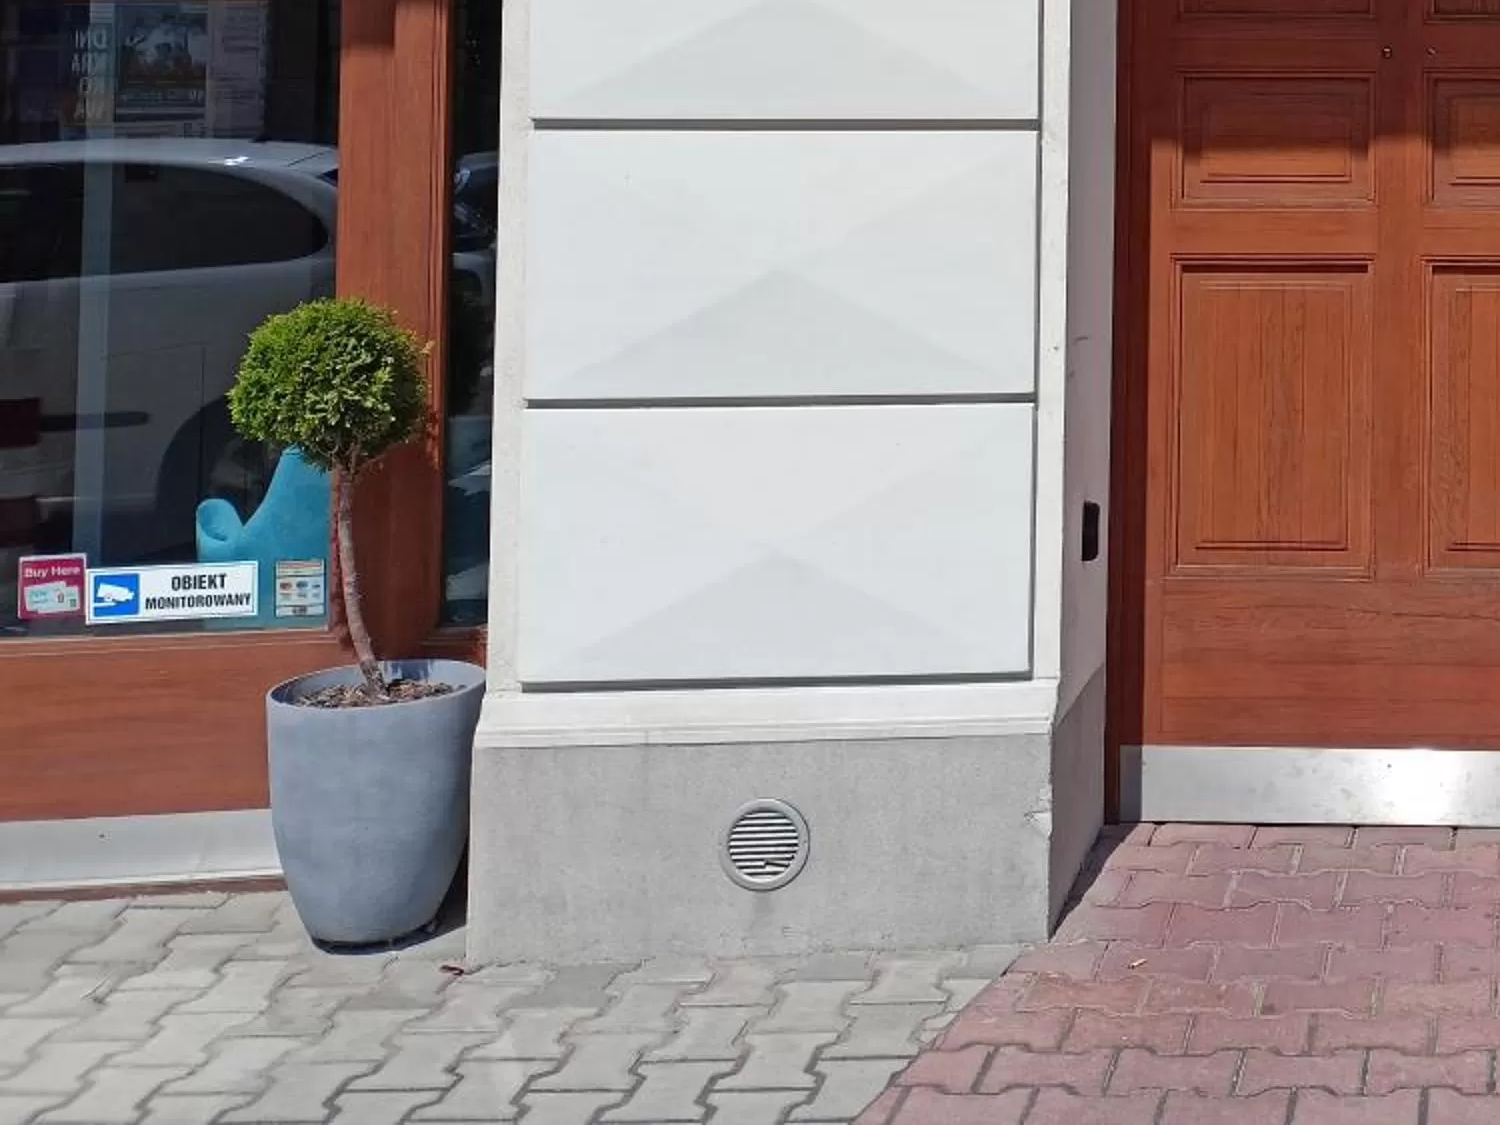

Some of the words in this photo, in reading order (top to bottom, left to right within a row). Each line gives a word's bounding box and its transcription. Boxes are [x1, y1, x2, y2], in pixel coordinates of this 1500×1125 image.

[24, 567, 48, 579] Buy
[51, 565, 80, 577] Here
[171, 573, 228, 591] OBIEKT
[145, 593, 251, 610] MONITOROWANY
